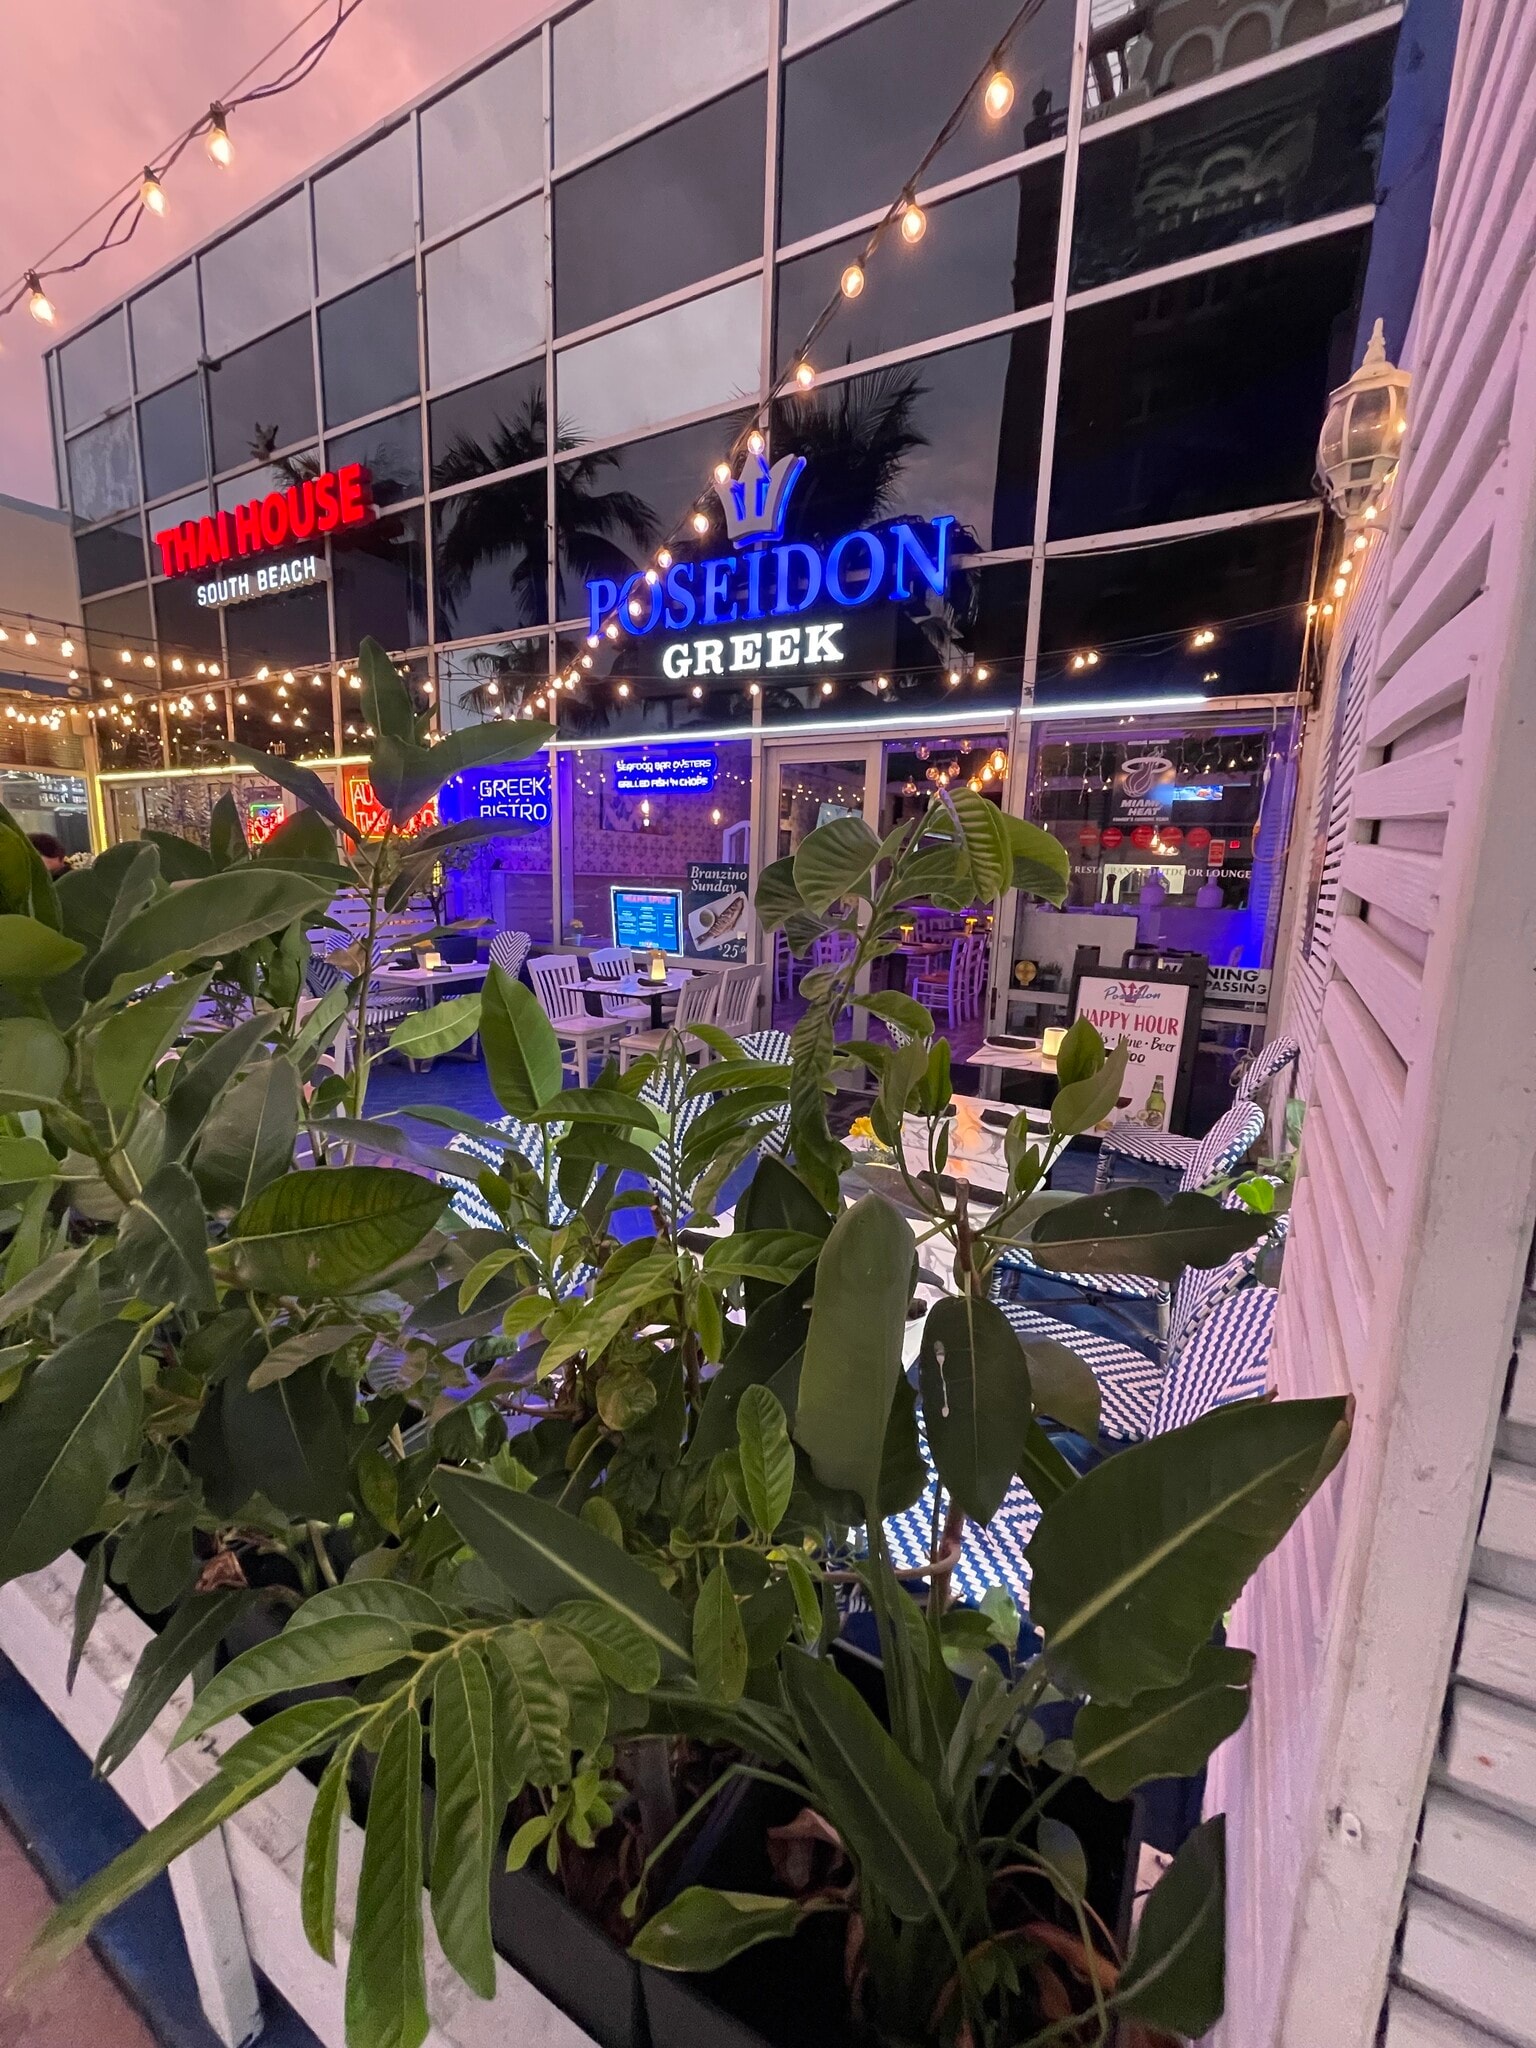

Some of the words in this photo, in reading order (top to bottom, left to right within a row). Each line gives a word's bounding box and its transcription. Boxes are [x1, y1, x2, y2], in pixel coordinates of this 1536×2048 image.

[156, 510, 231, 577] THAI
[235, 463, 367, 554] HOUSE
[197, 573, 250, 607] SOUTH
[257, 555, 317, 593] BEACH
[585, 515, 955, 640] POSEIDON
[662, 622, 845, 679] GREEK
[616, 761, 653, 772] SEAFOOD
[654, 761, 671, 770] BAR
[673, 759, 711, 769] OYSTERS
[480, 776, 546, 798] GREEK
[480, 803, 547, 821] BISTRO
[1120, 799, 1161, 808] MIAMI
[1127, 806, 1162, 816] HEAT
[690, 866, 748, 880] Branzino
[1206, 868, 1252, 879] LOUNGE
[691, 879, 737, 895] Sunday
[1134, 1014, 1179, 1036] HOUR
[1150, 1036, 1176, 1053] Beer
